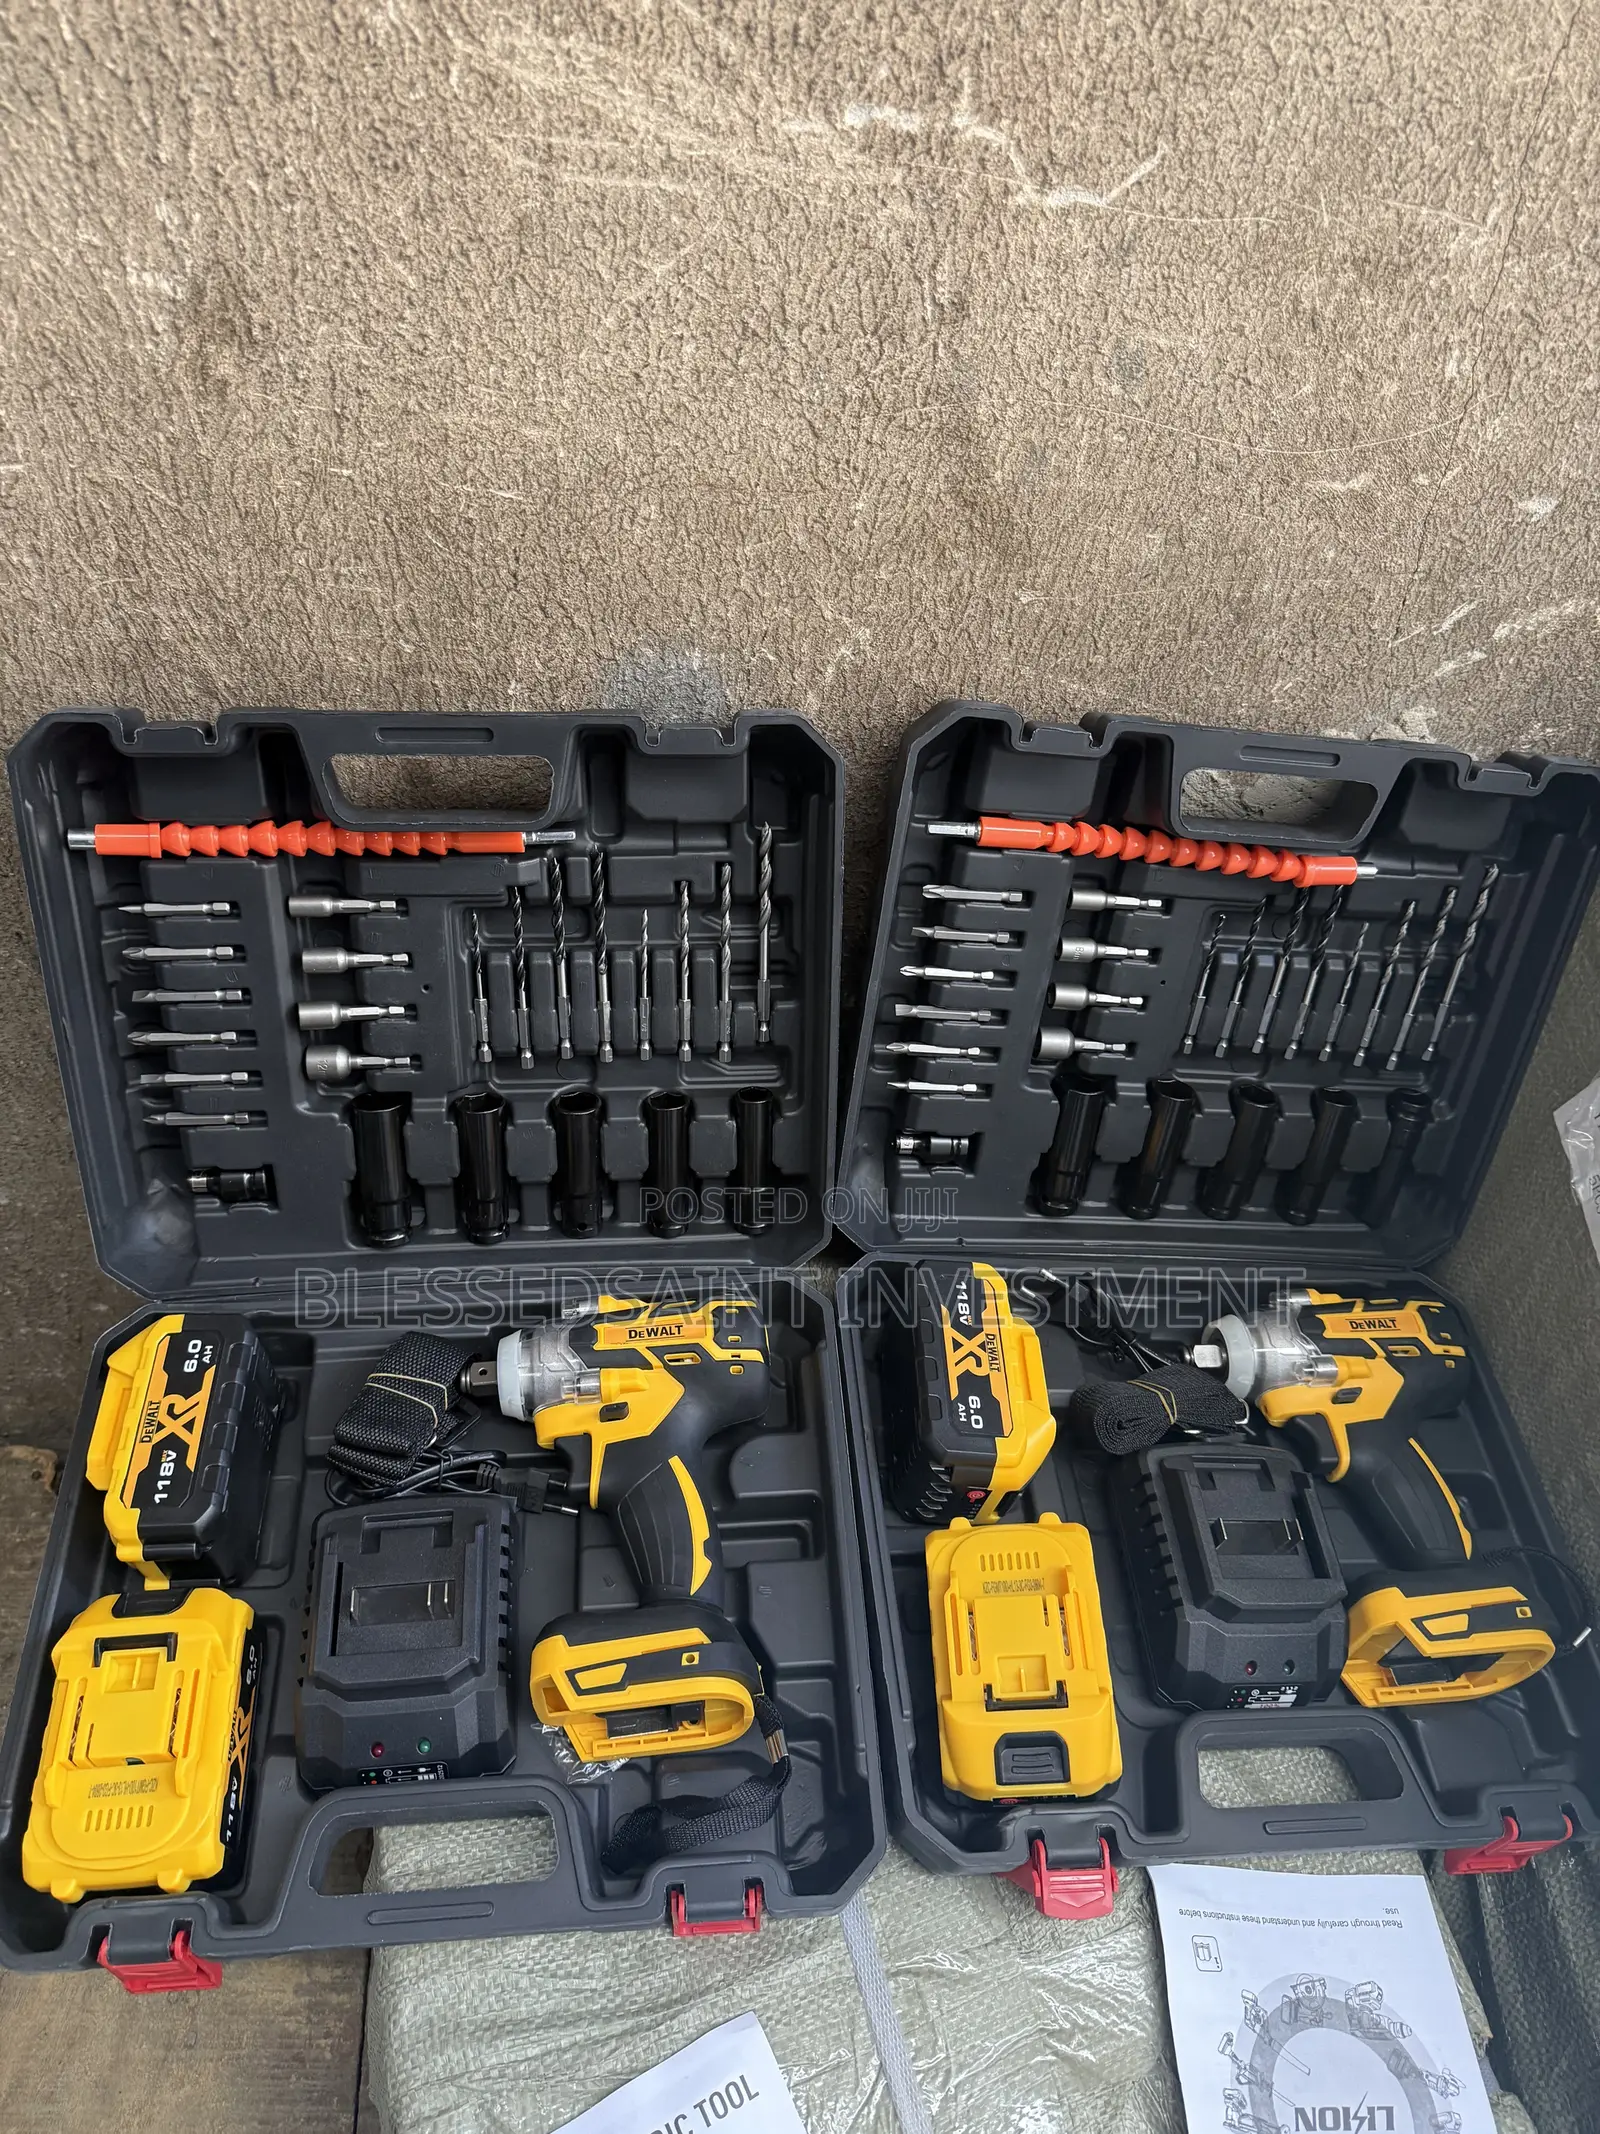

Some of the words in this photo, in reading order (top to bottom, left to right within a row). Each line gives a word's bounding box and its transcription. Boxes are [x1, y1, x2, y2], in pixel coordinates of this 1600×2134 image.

[184, 1339, 202, 1373] 6.0
[202, 1345, 214, 1364] AH
[957, 1403, 967, 1422] AH
[968, 1395, 984, 1430] 6.0
[154, 1450, 178, 1504] 118V
[1178, 1908, 1202, 1919] before
[1382, 1907, 1400, 1915] use.
[1202, 1911, 1241, 1923] instructions
[1242, 1914, 1261, 1925] these
[1262, 1916, 1301, 1928] understand
[1302, 1919, 1316, 1928] and
[1317, 1918, 1349, 1929] carefully
[1350, 1919, 1381, 1929] through
[1382, 1919, 1403, 1929] Read
[693, 2074, 760, 2128] TOOL
